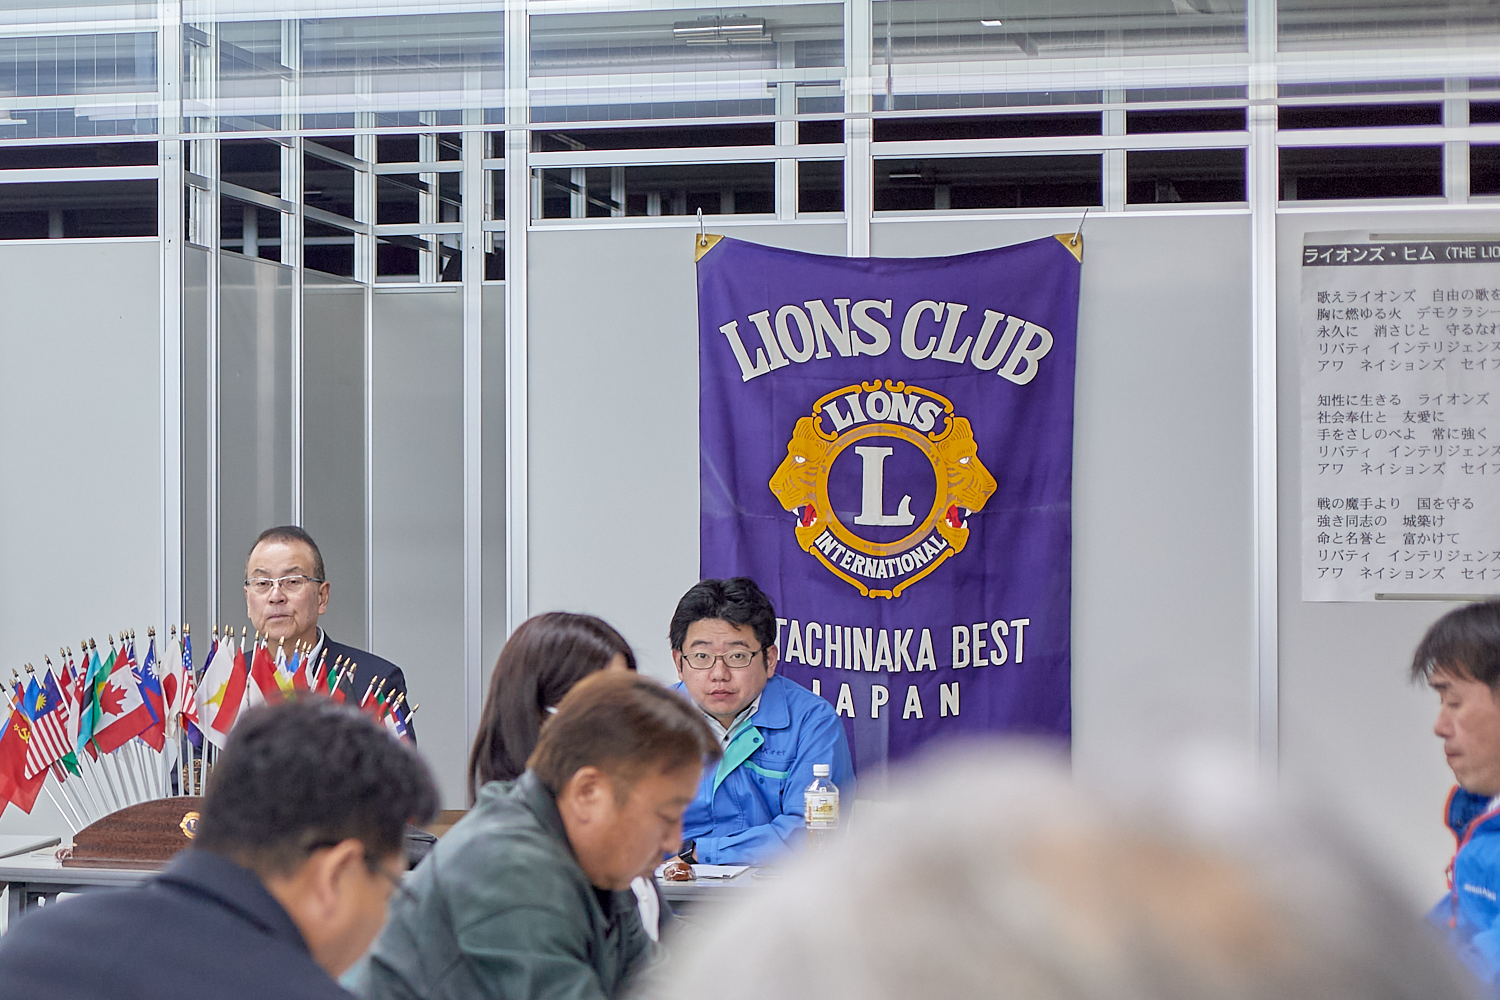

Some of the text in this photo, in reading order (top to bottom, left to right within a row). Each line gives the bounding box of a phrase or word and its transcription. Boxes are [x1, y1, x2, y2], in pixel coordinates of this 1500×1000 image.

[1317, 289, 1417, 303] 歌えライオンズ
[1317, 306, 1500, 320] 胸に燃ゆる火 デモクラシー
[1317, 324, 1359, 338] 永久に
[1373, 324, 1430, 338] 消さじと
[719, 298, 1054, 385] LIONS CLUB
[1319, 341, 1371, 355] リバティ
[1318, 358, 1344, 372] アワ
[1361, 357, 1446, 372] ネイションズ
[1318, 392, 1490, 406] 知性に生きる ライオンズ
[823, 390, 943, 432] LIONS
[1318, 410, 1445, 424] 社会奉仕と 友愛に
[1318, 427, 1487, 441] 手をさしのべよ 常に強く
[1320, 445, 1371, 459] リバティ
[1318, 462, 1344, 476] アワ
[1361, 462, 1446, 475] ネイションズ
[854, 446, 916, 526] L
[1318, 497, 1474, 511] 戦の魔手より 国を守る
[1318, 515, 1445, 528] 強き同志の 城築け
[1318, 532, 1460, 545] 命と名誉と 富かけて
[814, 534, 948, 579] INTERNATIONAL
[1319, 549, 1370, 563] リバティ
[1318, 567, 1344, 581] アワ
[1360, 567, 1446, 580] ネイションズ
[952, 618, 1030, 669] BEST
